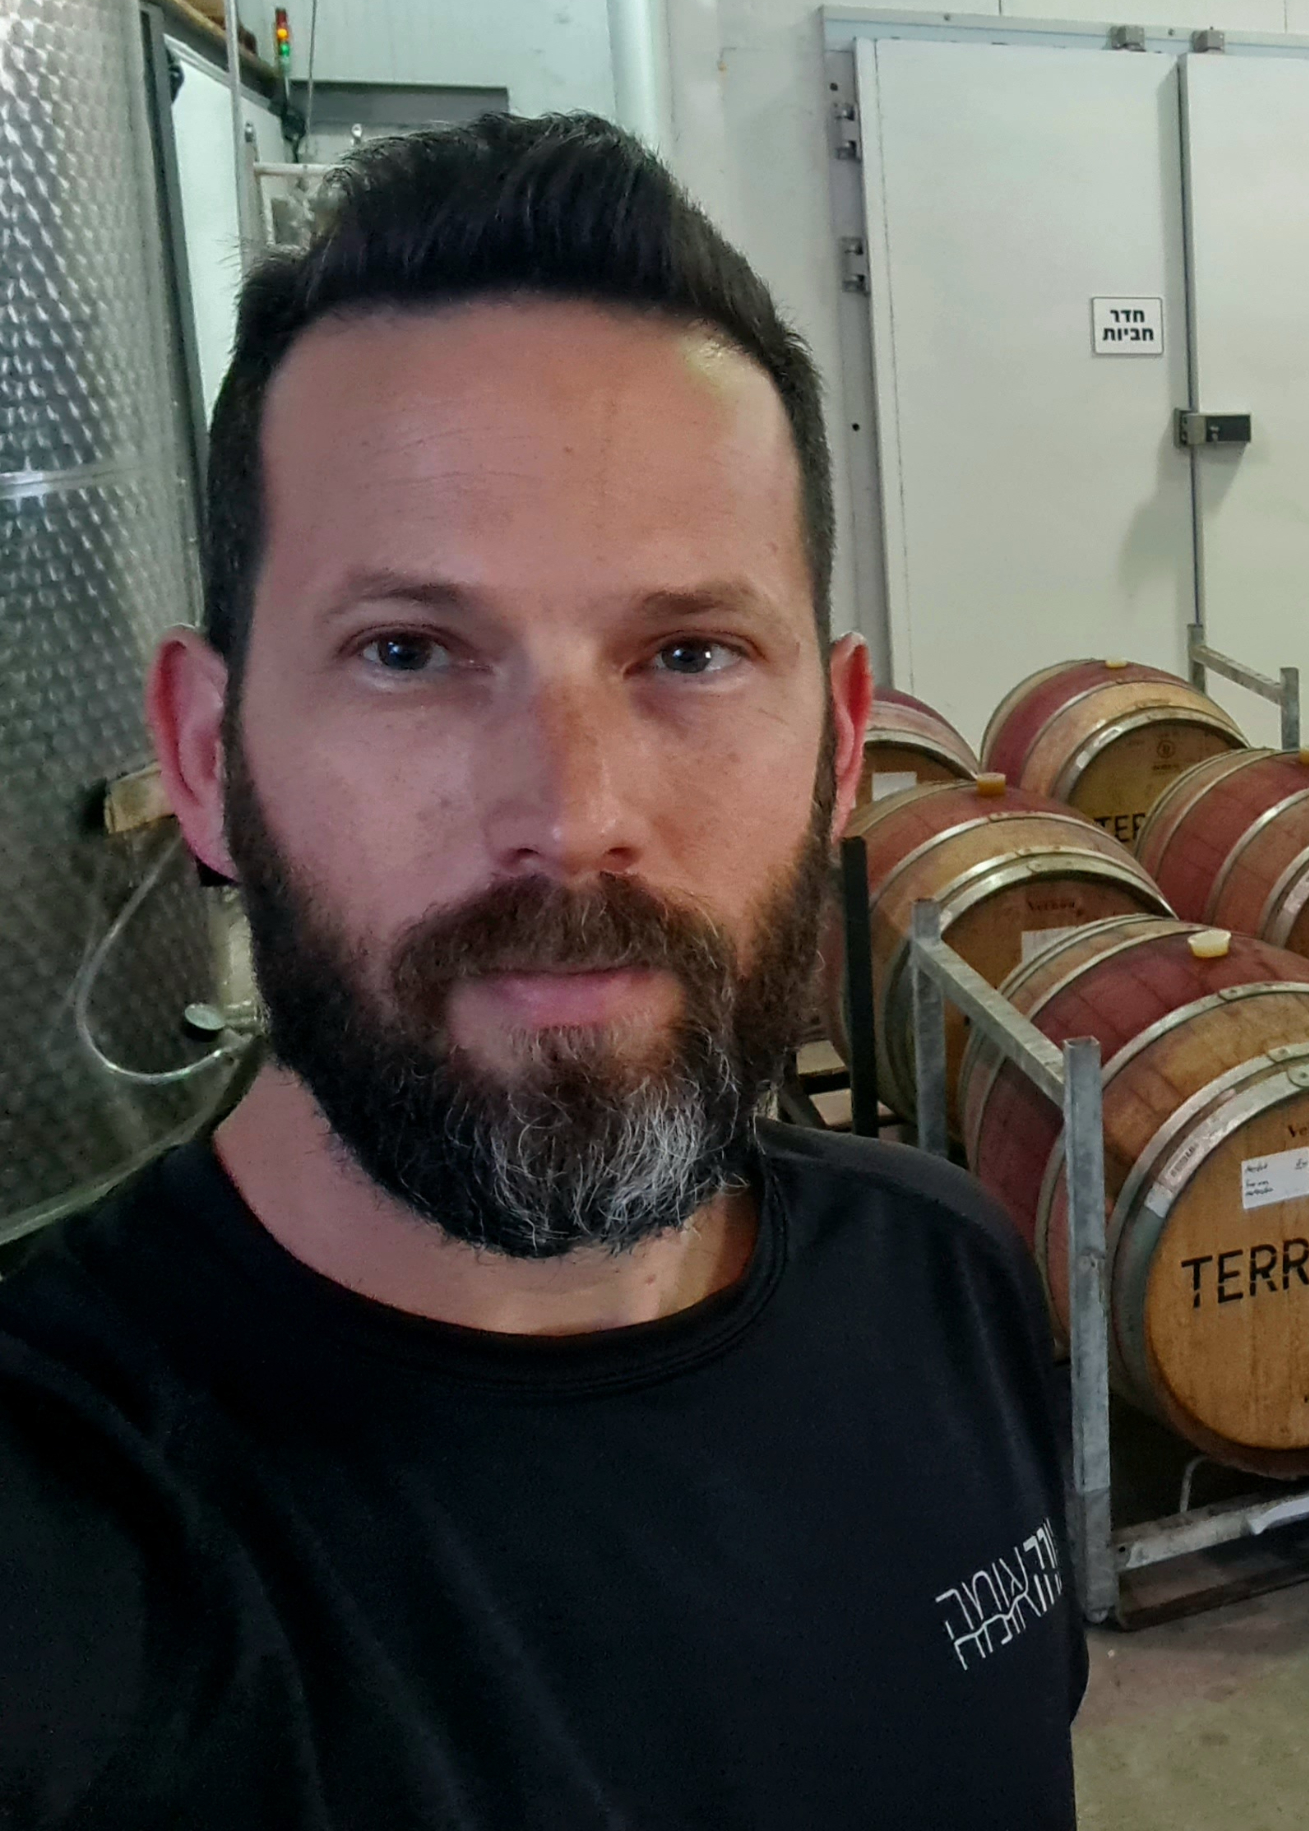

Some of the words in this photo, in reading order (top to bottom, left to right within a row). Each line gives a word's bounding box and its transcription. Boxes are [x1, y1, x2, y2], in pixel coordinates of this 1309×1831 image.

[1110, 309, 1145, 323] חדר
[1103, 327, 1154, 341] חביות
[1180, 1237, 1309, 1309] TERR
